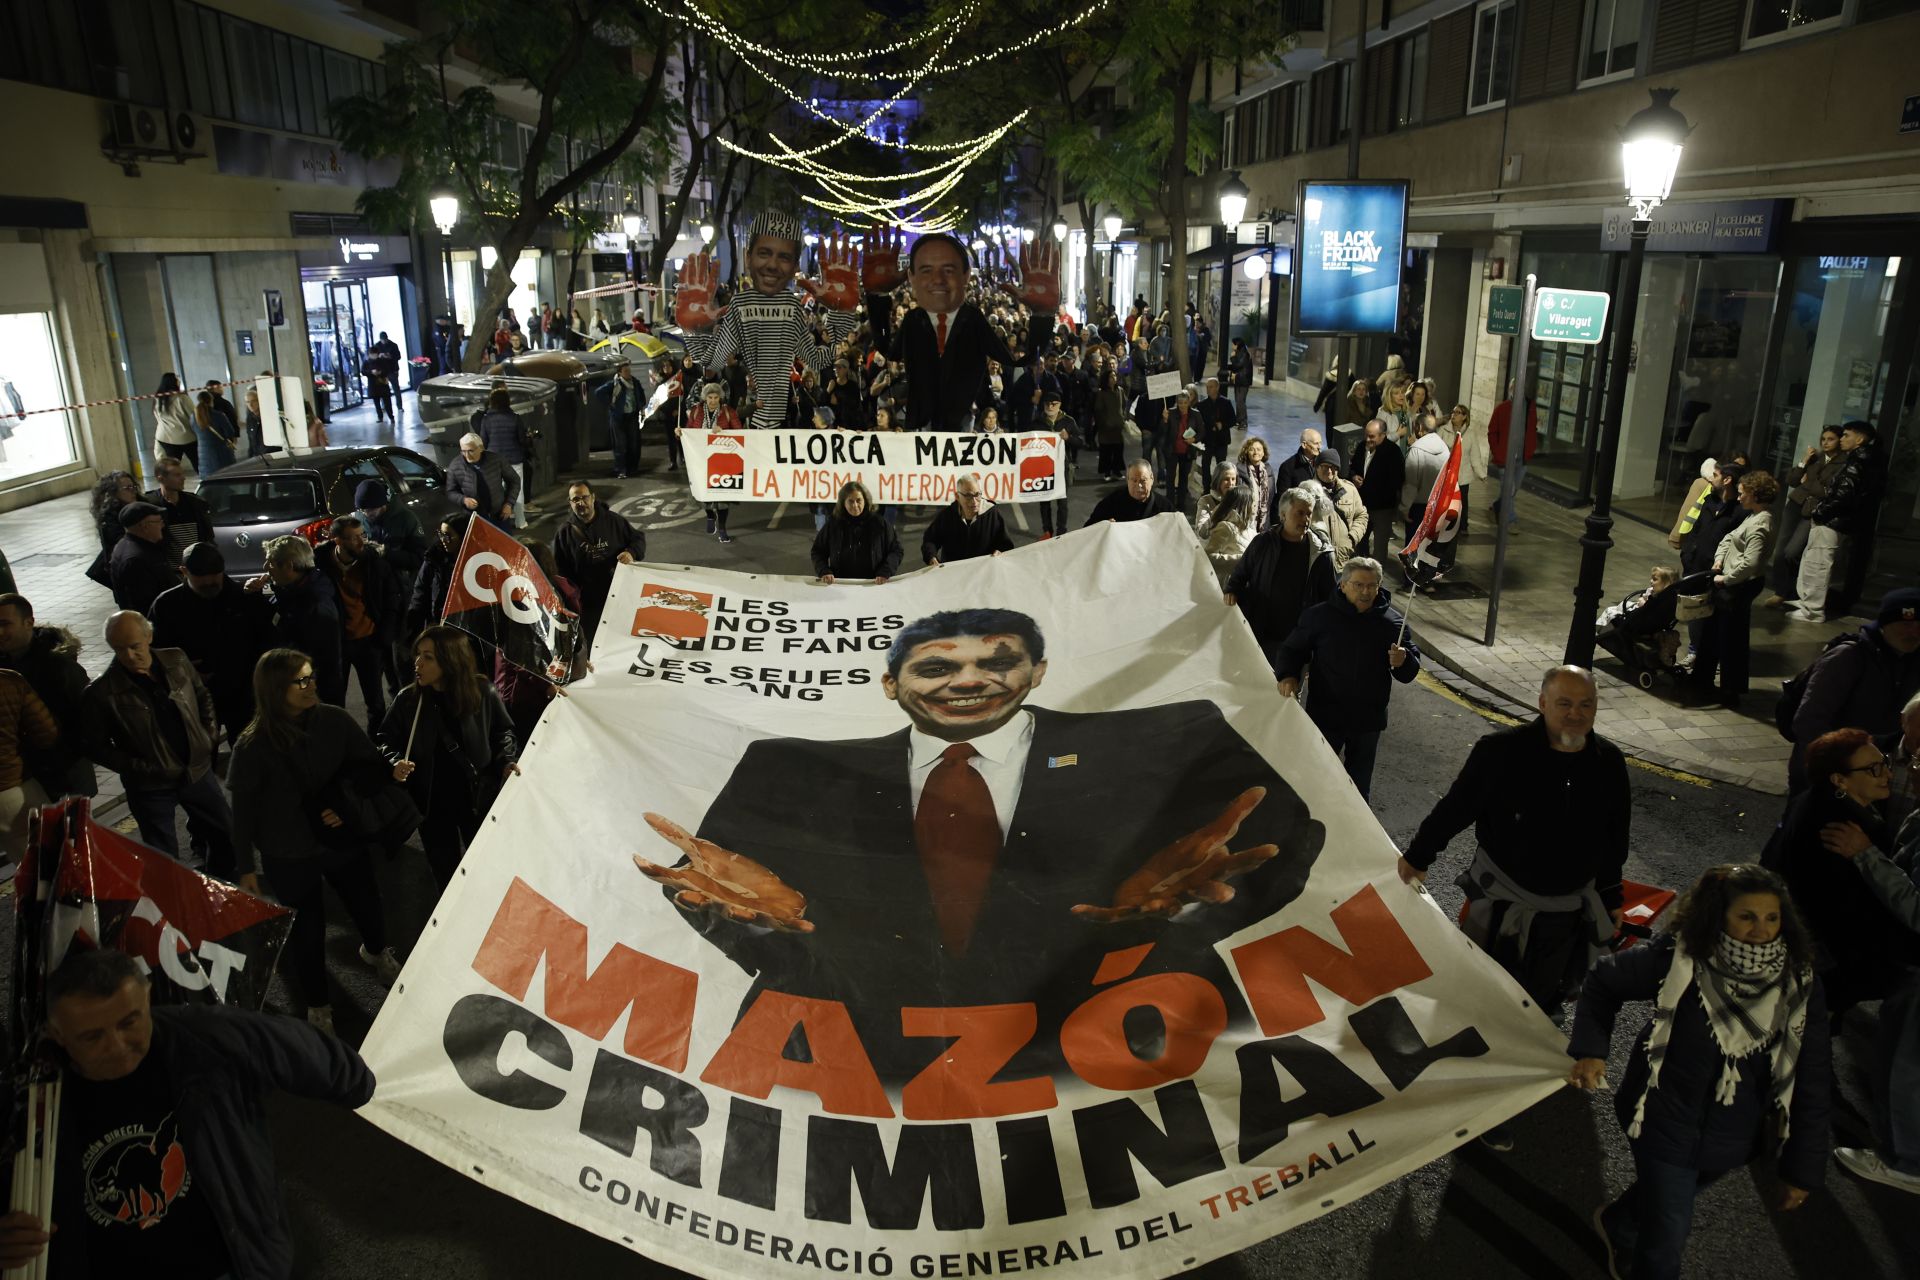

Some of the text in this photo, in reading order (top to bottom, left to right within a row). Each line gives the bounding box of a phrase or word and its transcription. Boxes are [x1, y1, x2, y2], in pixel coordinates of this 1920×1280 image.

[769, 220, 793, 235] 228
[1621, 220, 1711, 235] COELL BANKER
[1716, 214, 1765, 226] EXCELLENCE
[1322, 230, 1376, 247] BLACK
[1715, 227, 1763, 238] REAL ESTATE
[1322, 246, 1383, 262] FRIDAY
[743, 307, 793, 319] RIMINL
[1548, 312, 1593, 330] Vilaragut
[774, 433, 1017, 467] LLORCA MAZÓN
[708, 473, 744, 489] CGT
[752, 468, 781, 499] LA
[878, 473, 958, 502] MIERDA
[1021, 476, 1054, 492] CGT
[462, 551, 569, 651] CGT
[716, 596, 789, 616] LES
[713, 614, 905, 634] NOSTRES
[710, 634, 893, 654] DE FANG
[627, 662, 686, 684] DE
[636, 642, 872, 686] LES SEUES
[471, 876, 1434, 1121] MAZÓN
[443, 994, 1491, 1231] CRIMINAL
[103, 1123, 145, 1143] DIRECTA
[578, 1127, 1377, 1279] CONFEDERACIÓ GENERAL DEL TREBALL
